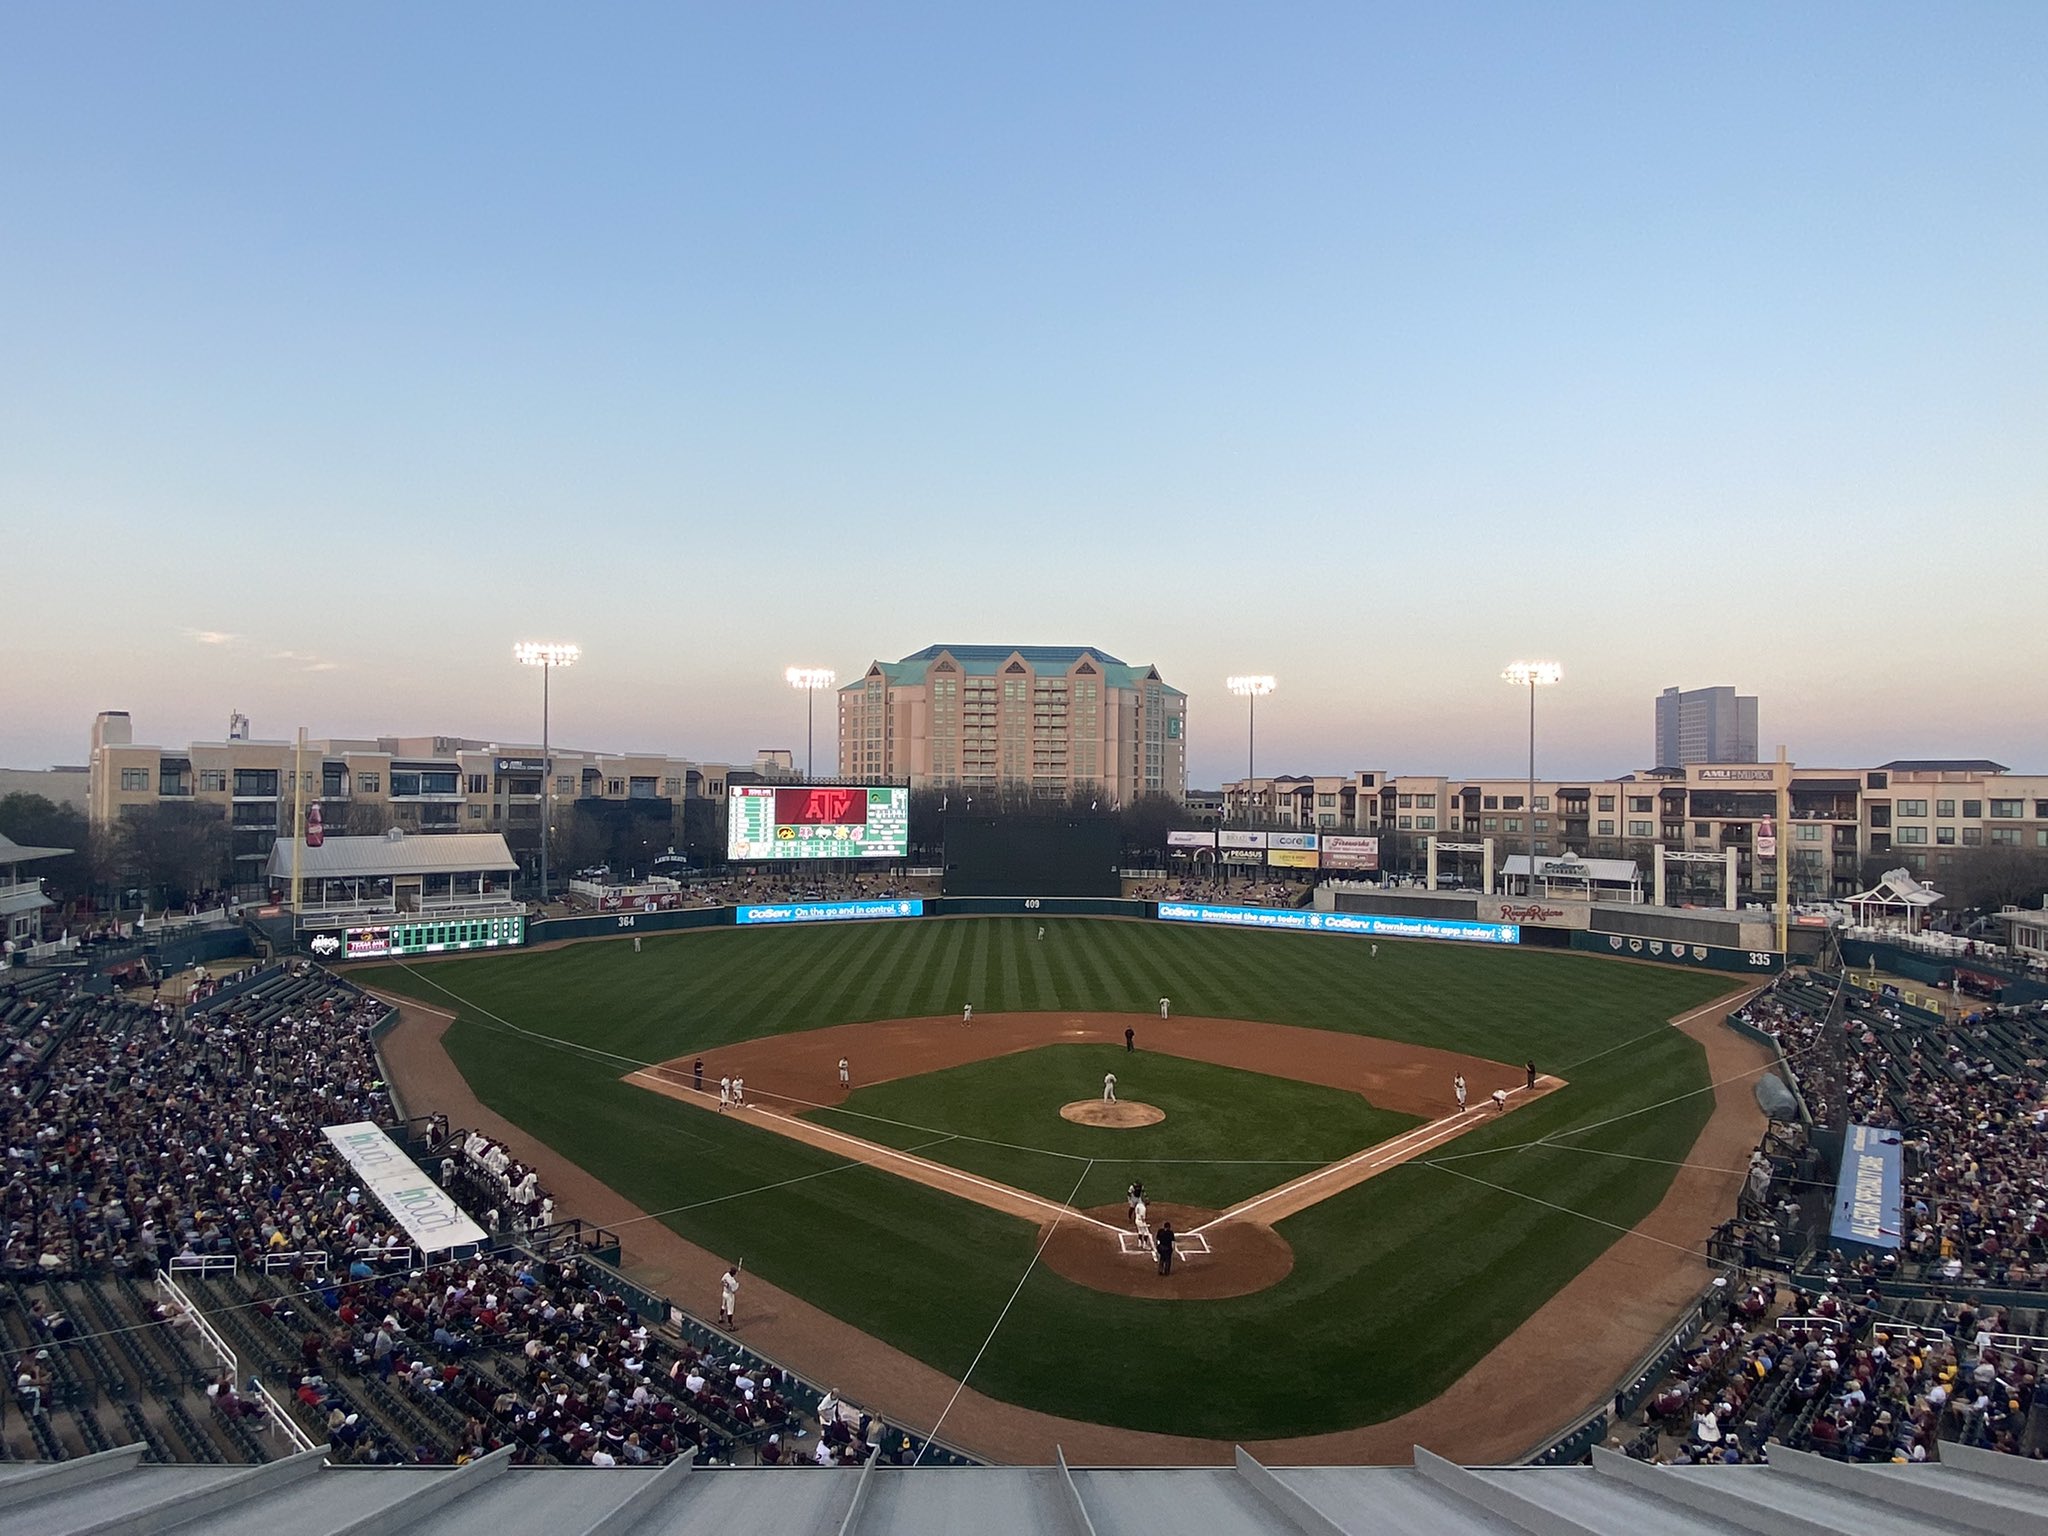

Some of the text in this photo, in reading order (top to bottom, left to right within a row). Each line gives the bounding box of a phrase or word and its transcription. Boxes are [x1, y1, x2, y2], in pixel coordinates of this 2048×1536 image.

[1231, 850, 1263, 858] PEGASUS
[1025, 900, 1040, 908] 409
[748, 906, 792, 918] CoServ
[795, 907, 808, 917] On
[810, 907, 825, 917] the
[826, 908, 838, 916] go
[839, 906, 854, 914] and
[1160, 906, 1199, 917] CoServ
[1202, 910, 1243, 920] Download
[1259, 915, 1276, 924] app
[1277, 915, 1306, 926] today!
[618, 916, 635, 927] 364
[1325, 917, 1496, 938] CoServ Download the app today!
[1749, 952, 1771, 966] 335
